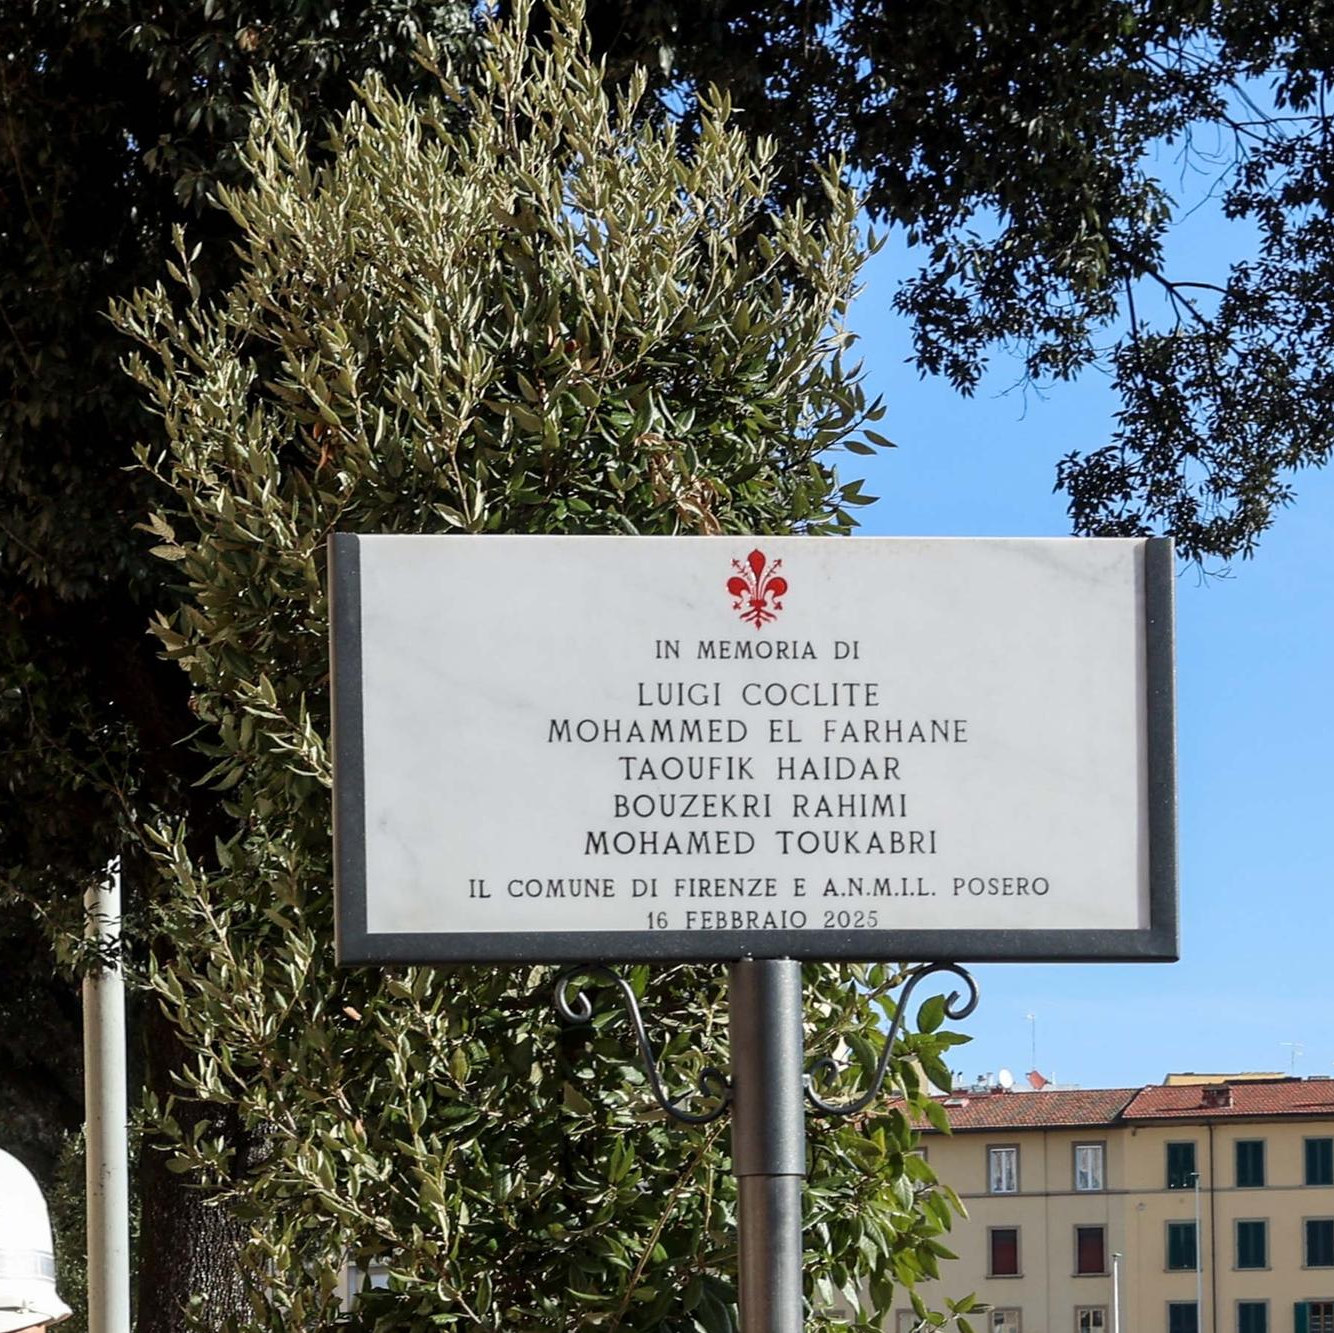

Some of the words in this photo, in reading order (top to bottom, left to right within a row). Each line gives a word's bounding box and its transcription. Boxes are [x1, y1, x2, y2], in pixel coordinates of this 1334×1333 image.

[655, 639, 680, 660] IN
[696, 640, 818, 660] MEMORIA
[834, 640, 860, 660] DI
[637, 682, 721, 707] LUIGI
[741, 682, 880, 707] COCLITE
[547, 718, 748, 744] MOHAMMED
[769, 719, 803, 744] EL
[824, 719, 968, 744] FARHANE
[618, 756, 754, 781] TAOUFIK
[777, 756, 901, 781] HAIDAR
[613, 793, 772, 819] BOUZEKRI
[792, 793, 907, 818] RAHIMI
[584, 830, 755, 856] MOHAMED
[774, 829, 937, 855] TOUKABRI
[468, 878, 492, 899] IL
[507, 878, 616, 899] COMUNE
[631, 878, 658, 898] DI
[674, 877, 778, 898] FIRENZE
[793, 877, 807, 898] E
[822, 877, 936, 897] A.N.M.I.L.
[953, 876, 1050, 897] POSERO
[647, 911, 669, 930] 16
[686, 910, 807, 931] FEBBRAIO
[823, 910, 879, 931] 2025
